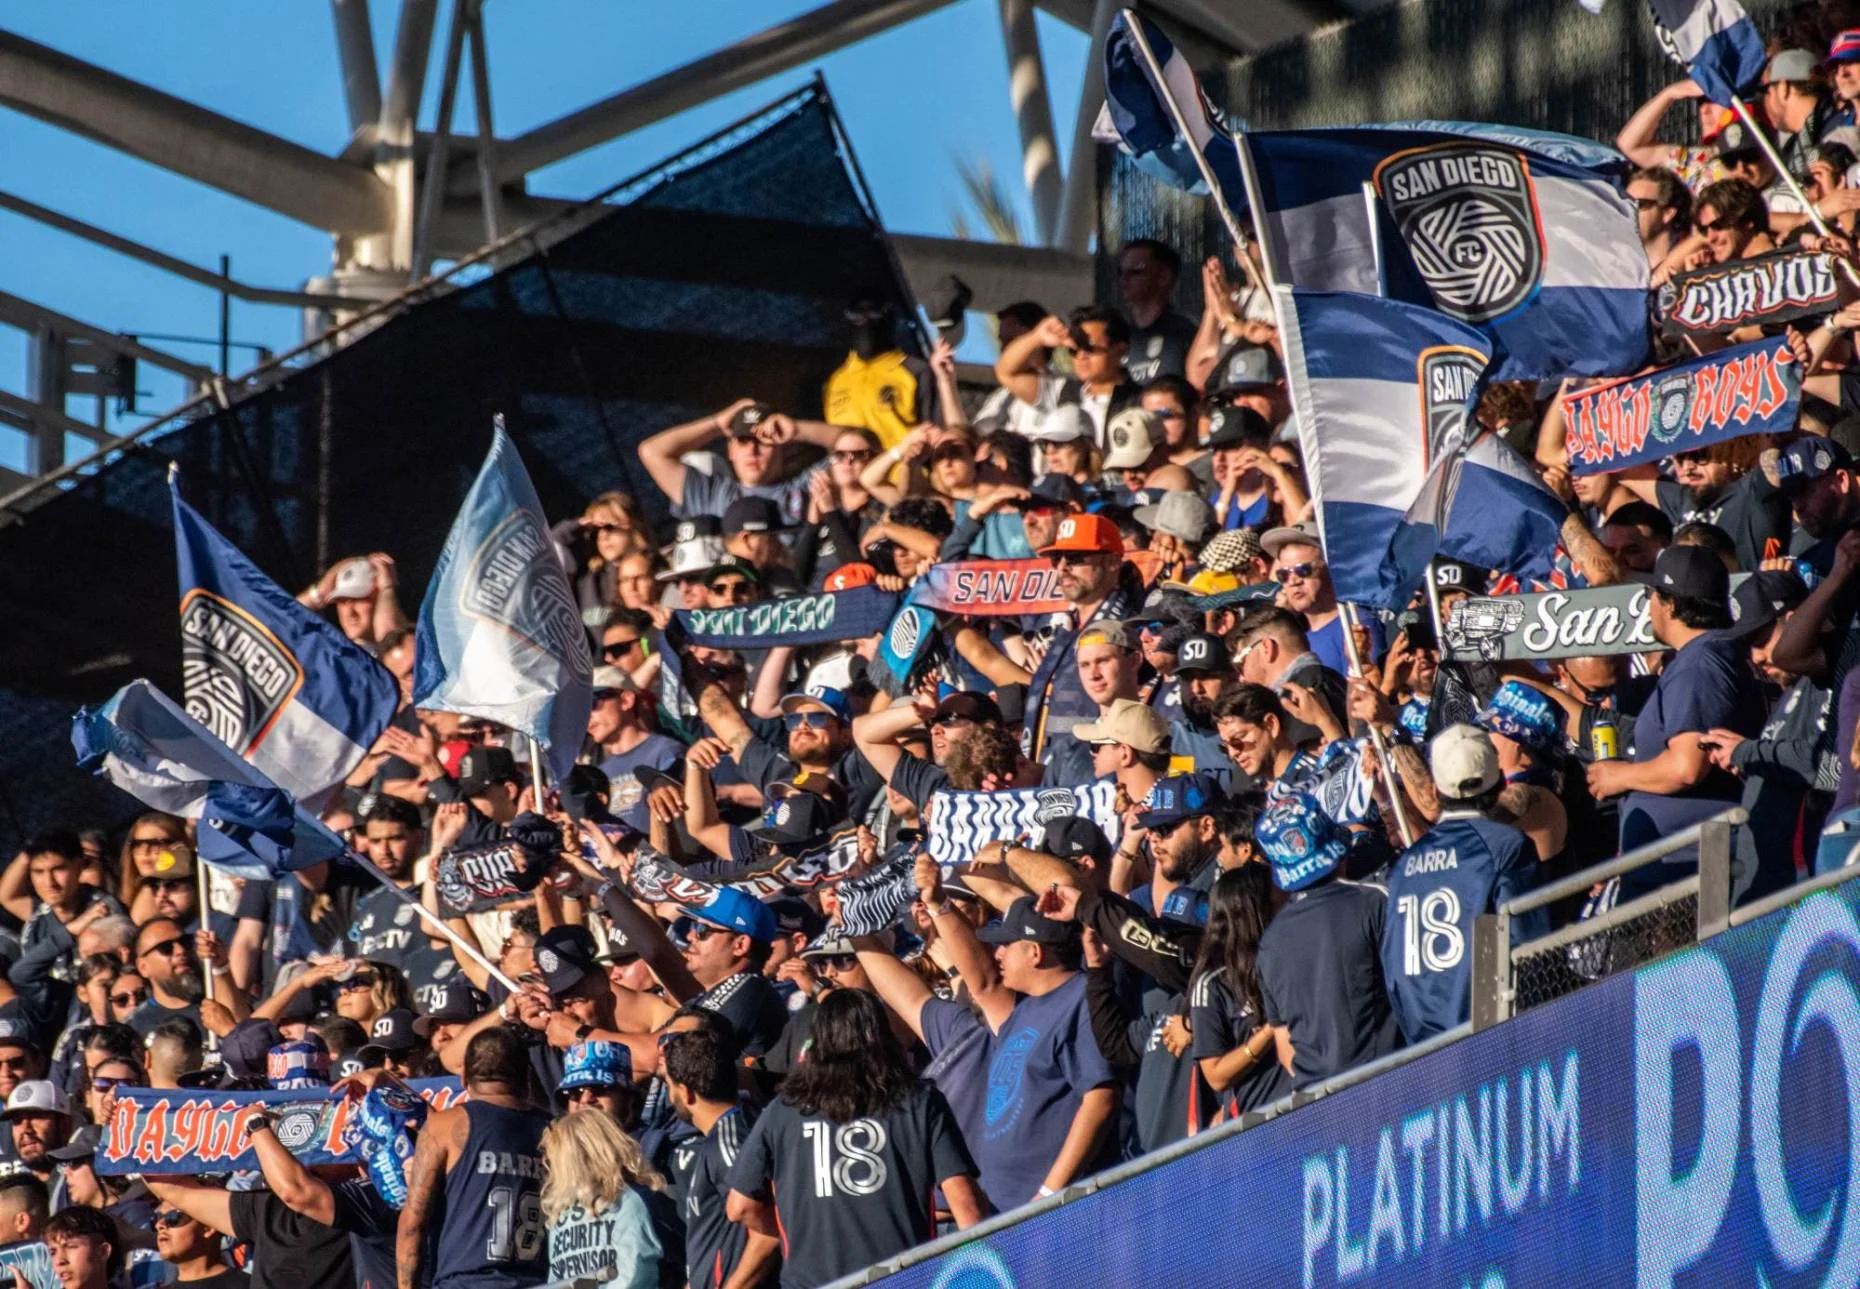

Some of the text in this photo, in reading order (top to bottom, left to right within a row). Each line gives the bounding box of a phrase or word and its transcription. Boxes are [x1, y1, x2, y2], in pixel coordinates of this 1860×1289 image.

[1391, 155, 1517, 201] SAN DIEGO
[1454, 239, 1482, 263] FC
[1678, 252, 1838, 326] CHAVOS
[1432, 364, 1464, 403] SAN
[1688, 345, 1795, 435] BOYS
[952, 569, 1018, 605] SAN
[1436, 564, 1462, 585] SD
[748, 592, 836, 636] DIEGO
[1522, 593, 1625, 653] San
[184, 605, 288, 698] SAN DIEGO
[1182, 638, 1208, 661] SD
[1404, 847, 1458, 878] BARRA
[1397, 886, 1465, 976] 18
[373, 1017, 394, 1038] SD
[477, 1150, 547, 1179] BARR
[802, 1117, 888, 1197] 18
[1301, 1047, 1580, 1289] PLATINUM
[486, 1186, 547, 1262] 18
